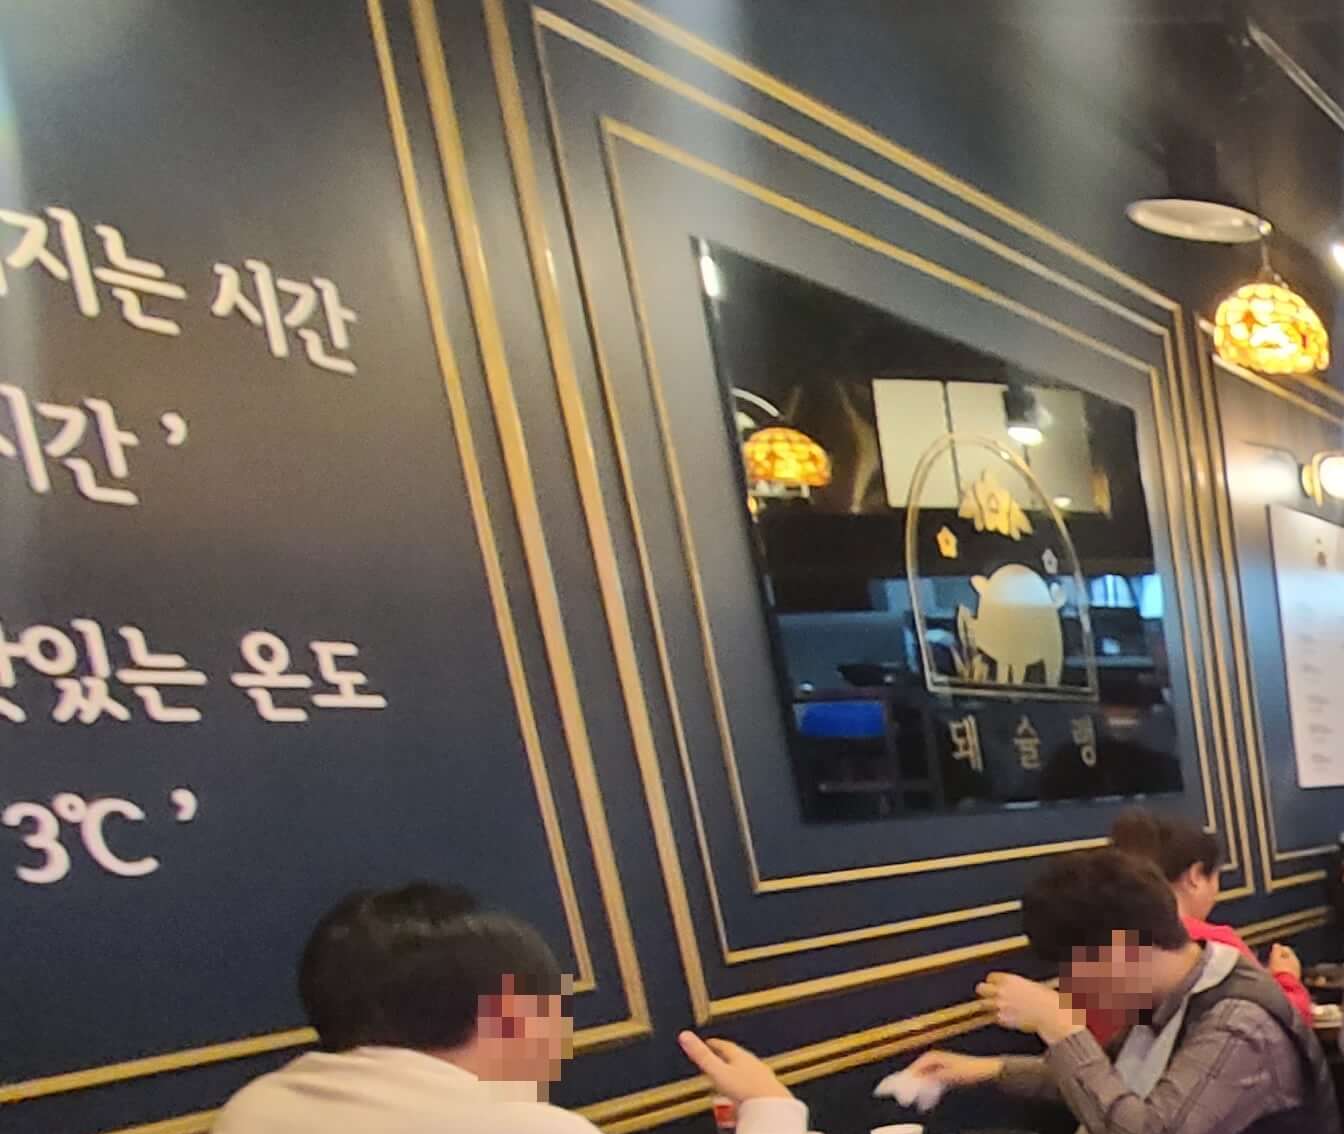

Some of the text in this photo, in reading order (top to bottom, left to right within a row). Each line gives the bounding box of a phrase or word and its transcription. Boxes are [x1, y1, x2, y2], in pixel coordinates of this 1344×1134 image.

[0, 206, 357, 374] 지는 시간
[231, 631, 387, 722] 온도
